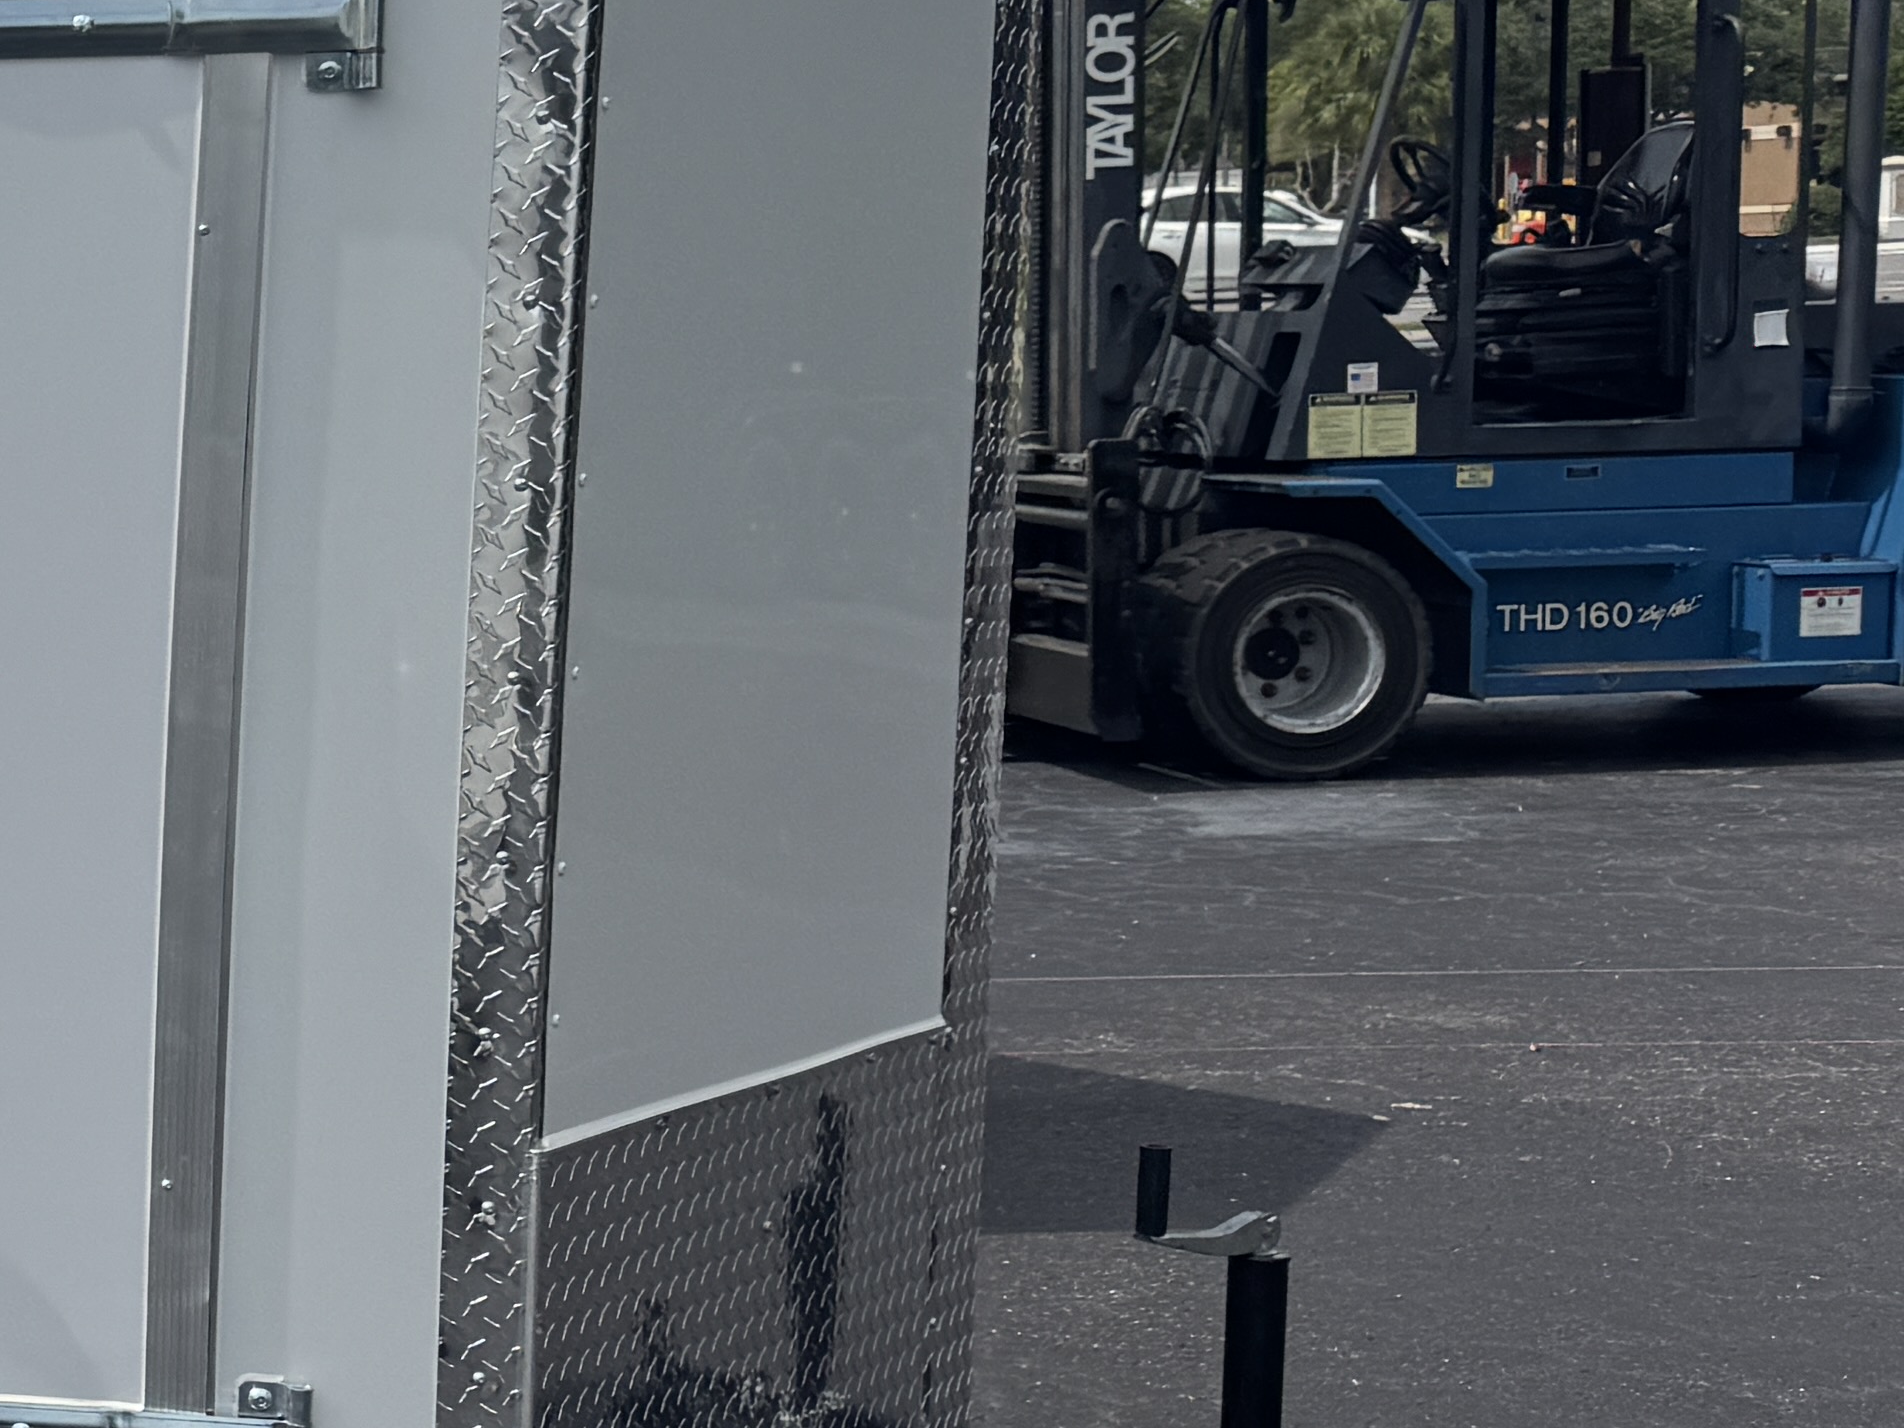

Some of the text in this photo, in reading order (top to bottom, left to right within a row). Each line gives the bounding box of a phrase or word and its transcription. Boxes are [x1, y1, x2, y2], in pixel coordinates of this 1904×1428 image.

[1085, 11, 1136, 180] TAYLOR
[1495, 601, 1570, 632] THD
[1575, 600, 1634, 630] 160
